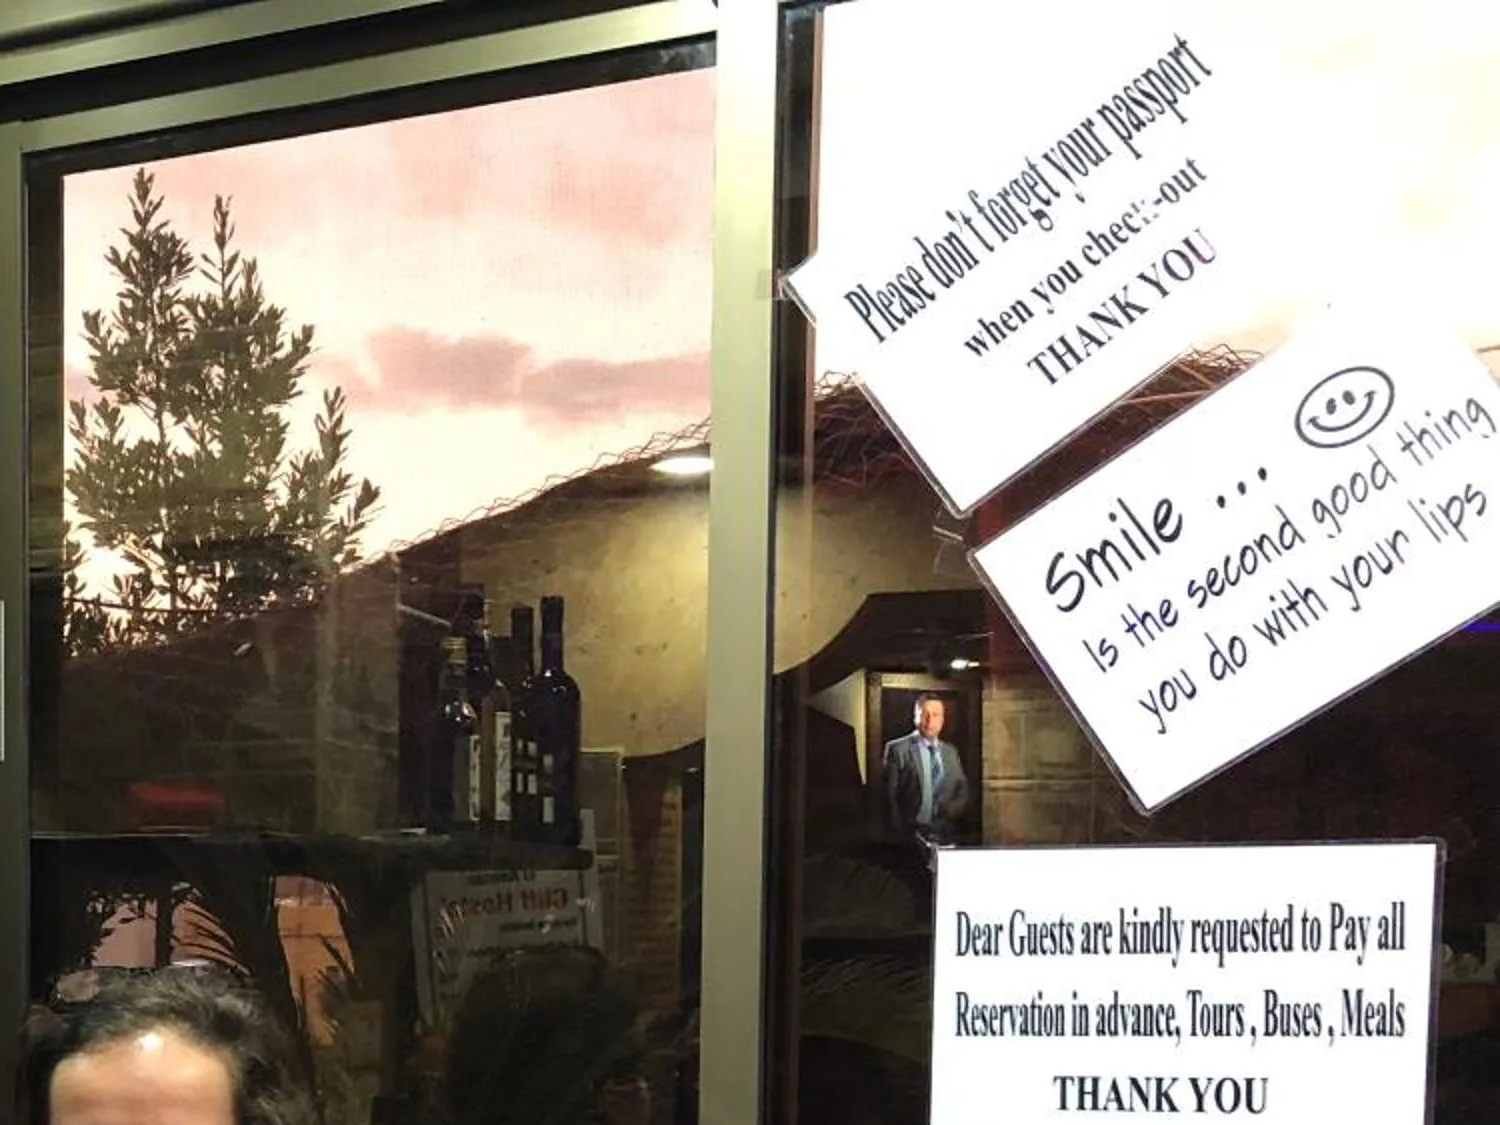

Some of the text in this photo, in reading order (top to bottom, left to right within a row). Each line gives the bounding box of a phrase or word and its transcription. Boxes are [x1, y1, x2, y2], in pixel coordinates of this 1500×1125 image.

[844, 32, 1212, 344] Please don't forget your passport
[964, 298, 1035, 357] when
[1030, 258, 1083, 315] you
[1027, 228, 1218, 386] THANK YOU
[1045, 498, 1183, 612] Smile
[1082, 397, 1498, 672] Is the second good thing
[1138, 484, 1487, 734] you do with your lips
[955, 901, 1405, 968] Dear Guests are kindly requested to Pay all
[955, 990, 1065, 1037] Reservation
[1071, 990, 1090, 1037] in
[1095, 990, 1181, 1048] advance,
[1340, 987, 1405, 1037] Meals
[1053, 1075, 1269, 1115] THANK YOU
